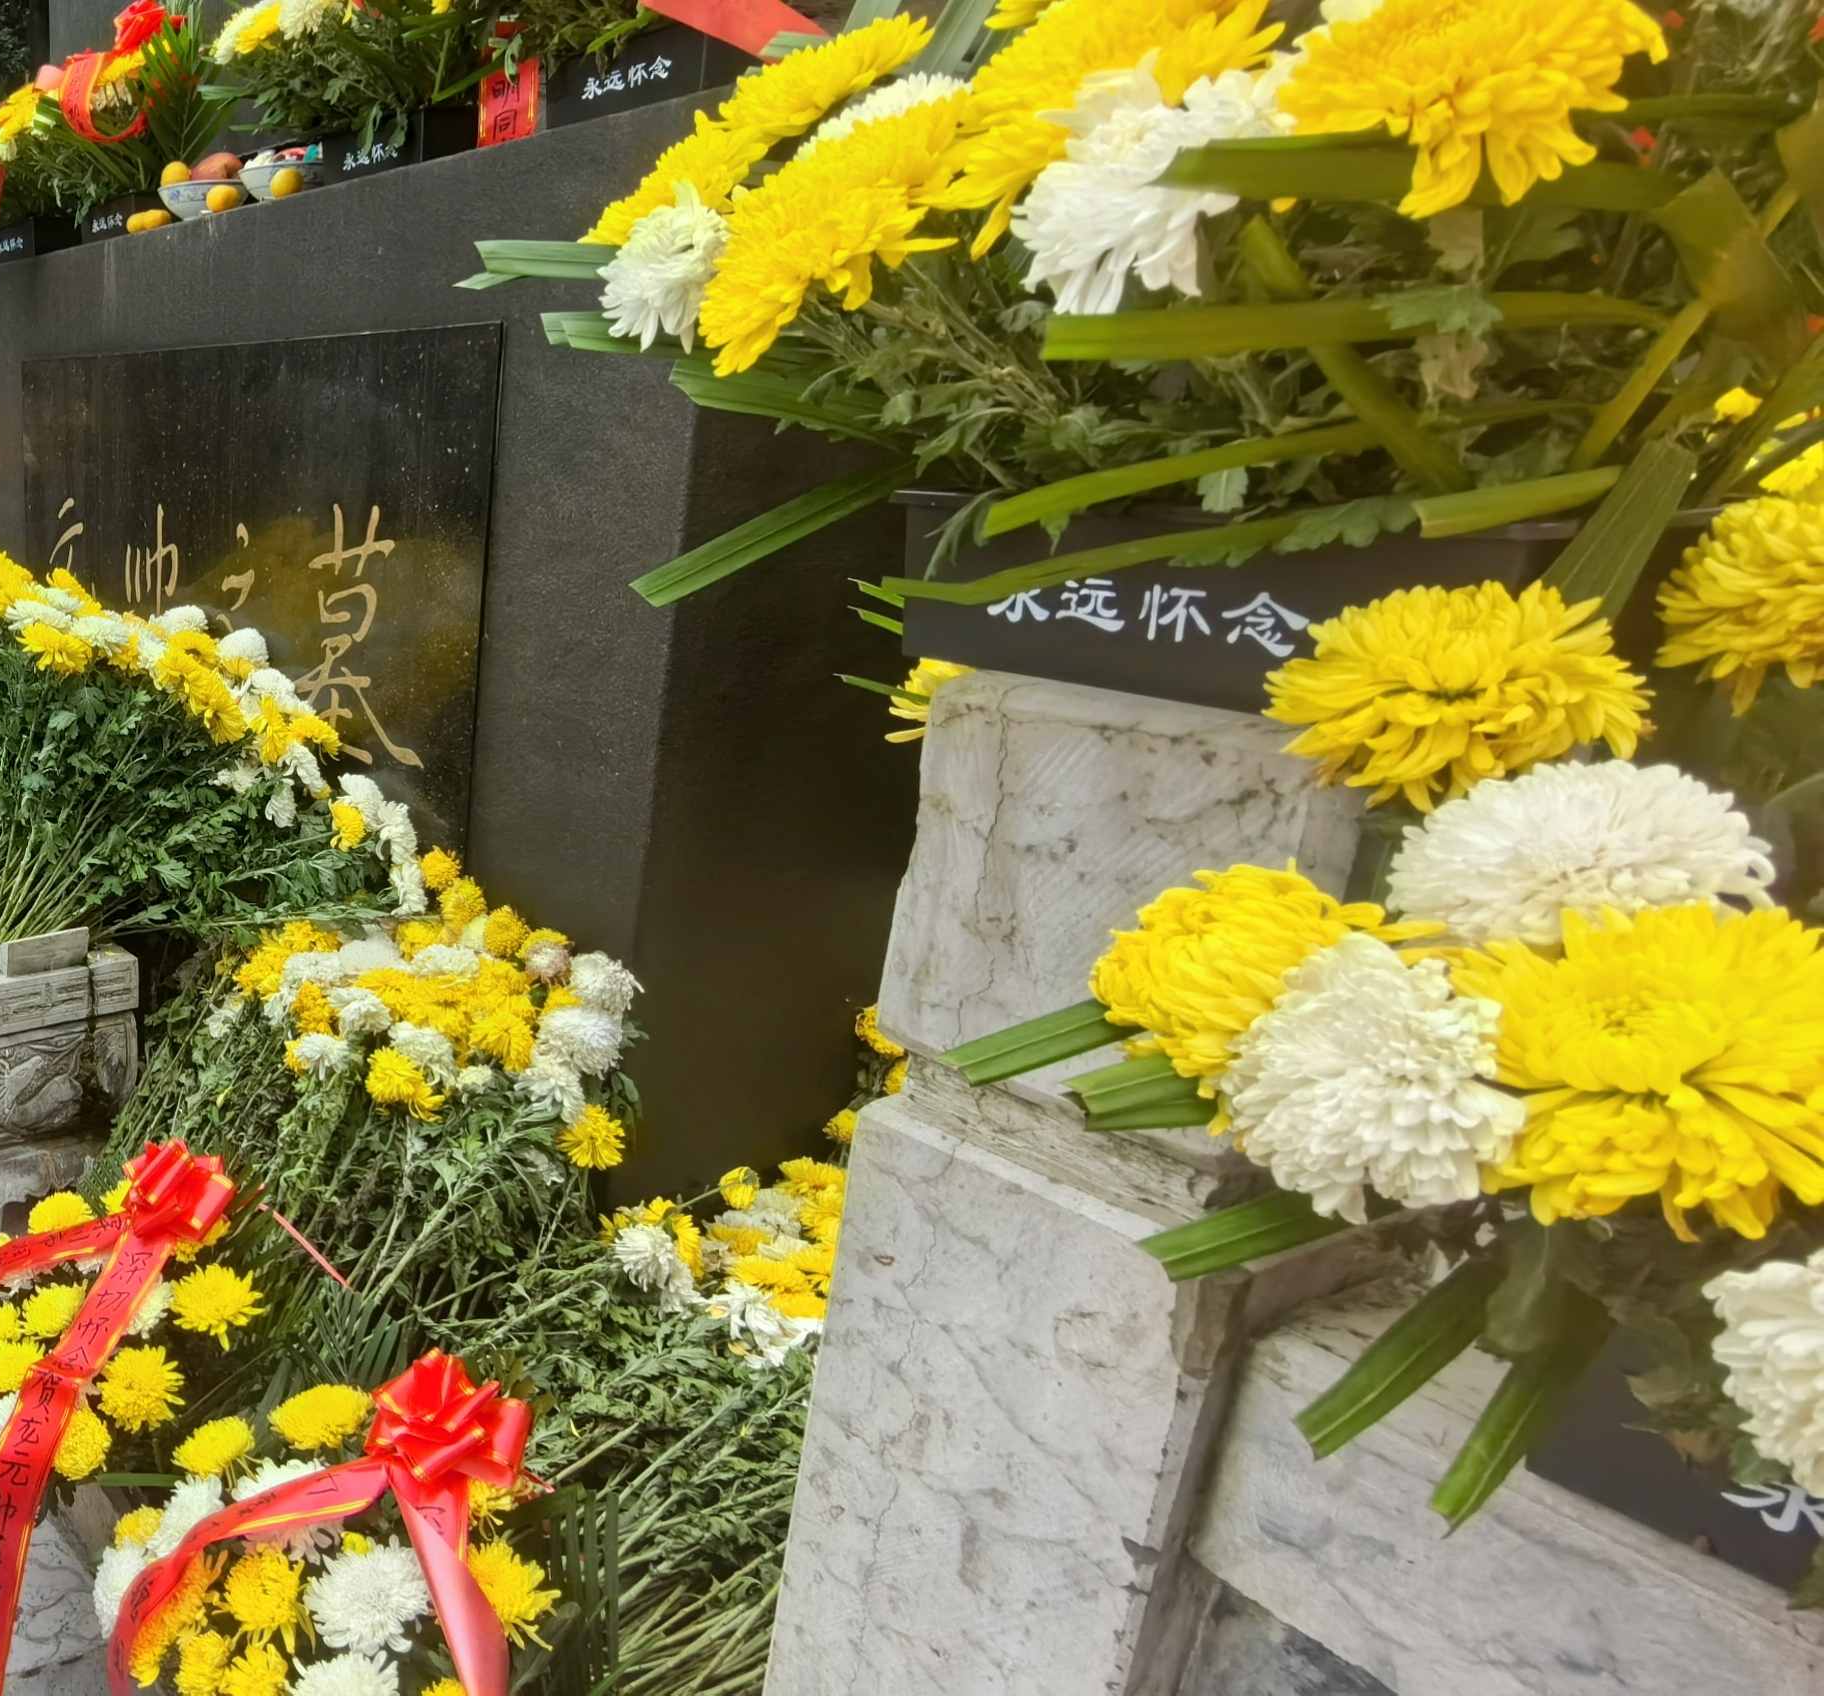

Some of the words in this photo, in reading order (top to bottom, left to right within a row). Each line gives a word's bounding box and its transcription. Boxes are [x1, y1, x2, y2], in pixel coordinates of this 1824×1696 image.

[491, 76, 522, 141] 明同
[581, 55, 672, 101] 永远怀念
[987, 576, 1310, 658] 永远怀念
